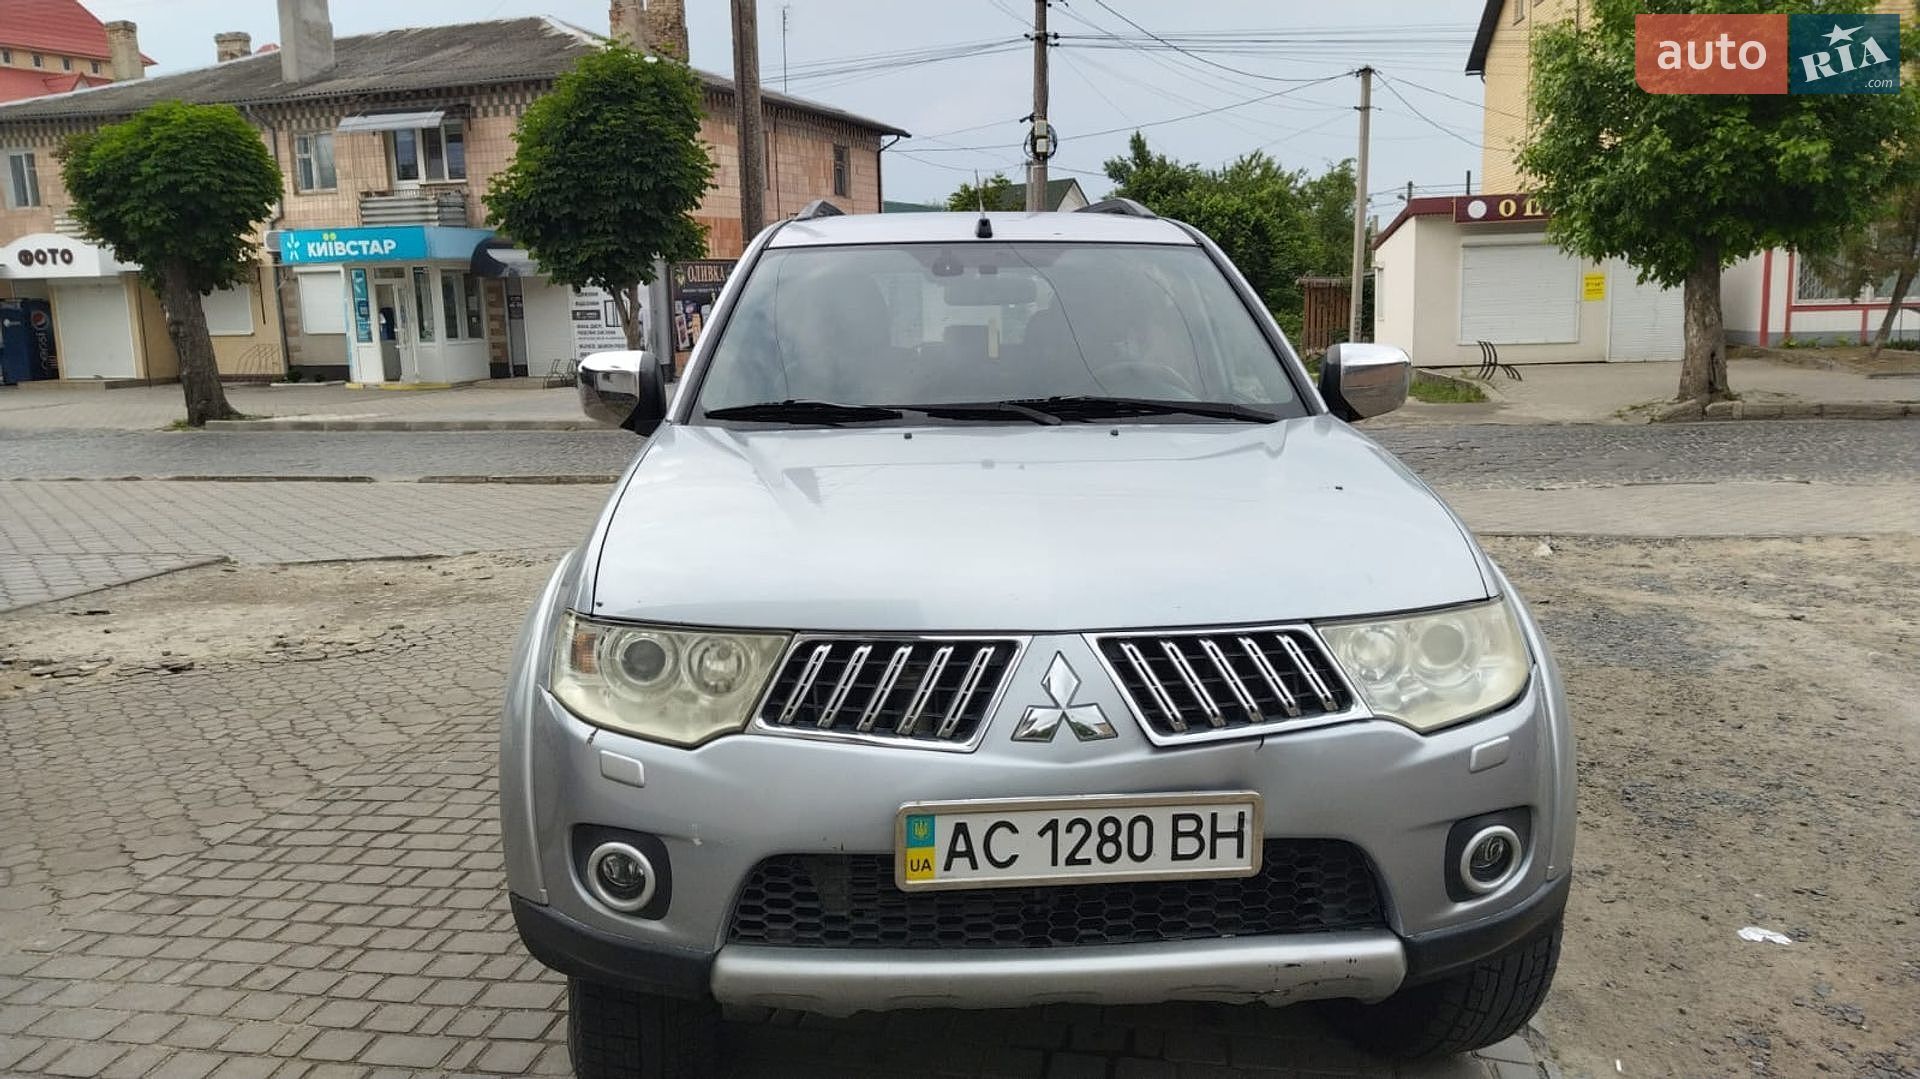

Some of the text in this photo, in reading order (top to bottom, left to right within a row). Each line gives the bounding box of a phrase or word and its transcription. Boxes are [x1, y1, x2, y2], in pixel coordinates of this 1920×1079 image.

[307, 232, 397, 258] КИЇВСТАР
[18, 248, 73, 266] ФОТО
[687, 265, 726, 282] ОЛИВКА
[943, 811, 1246, 872] AC 1280 BH
[910, 858, 932, 872] UA
